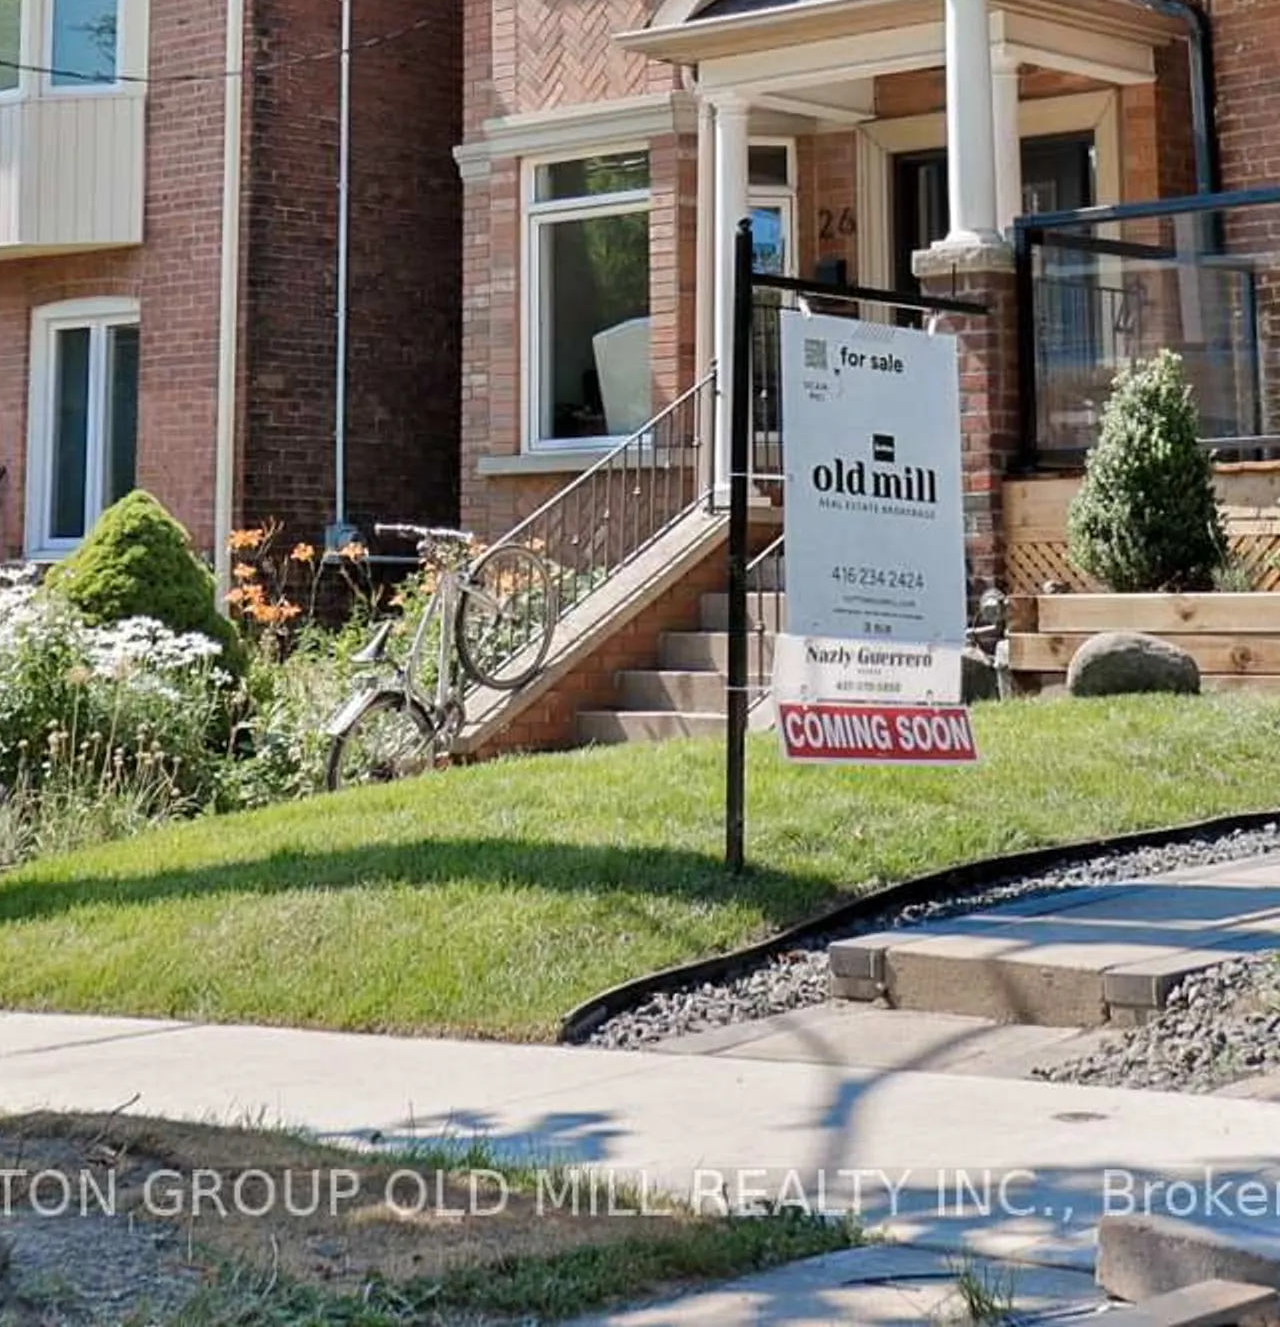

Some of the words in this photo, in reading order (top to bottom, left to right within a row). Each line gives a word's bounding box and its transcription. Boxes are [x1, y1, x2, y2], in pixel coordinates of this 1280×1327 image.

[818, 207, 857, 240] 26
[840, 345, 866, 367] for
[870, 353, 904, 373] sale
[813, 458, 866, 496] old
[872, 466, 937, 503] mill
[832, 566, 857, 584] 416
[859, 567, 886, 586] 234
[888, 570, 925, 589] 2424
[806, 646, 851, 669] Nazly
[858, 647, 933, 668] Guerrero
[785, 711, 893, 751] COMING
[895, 715, 971, 752] SOON
